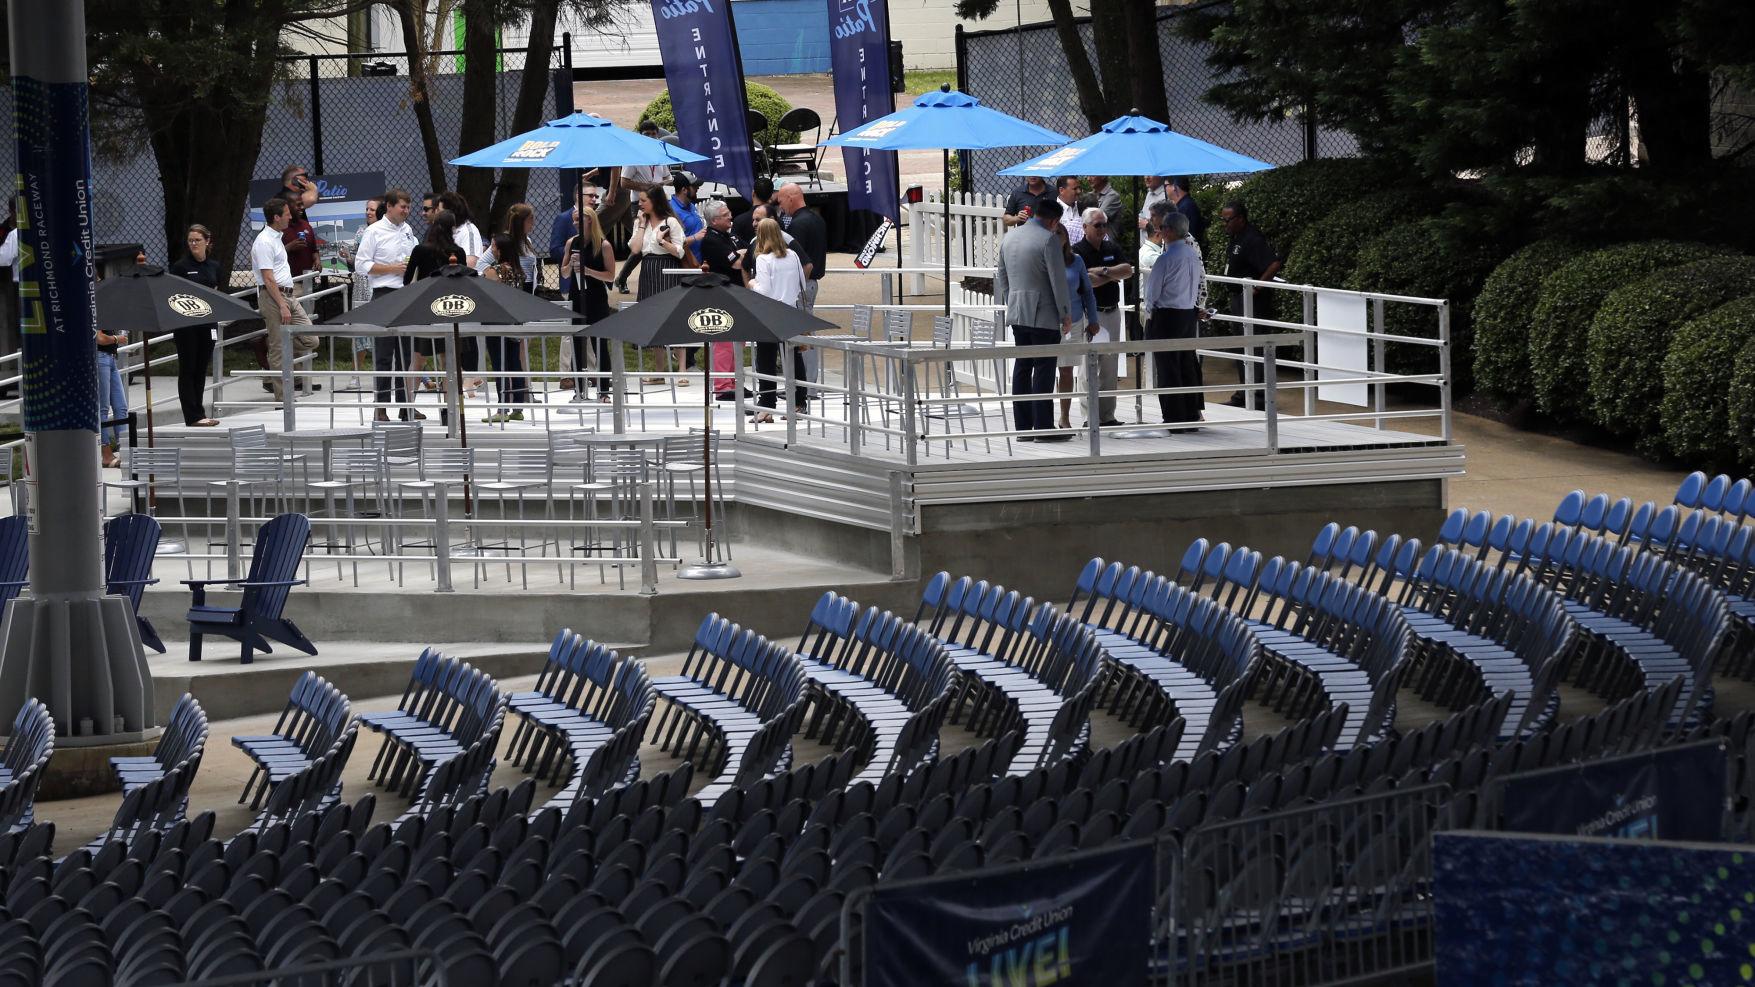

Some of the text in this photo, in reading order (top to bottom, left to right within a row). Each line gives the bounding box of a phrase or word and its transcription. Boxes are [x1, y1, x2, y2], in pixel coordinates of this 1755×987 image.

[75, 179, 88, 227] Union
[29, 174, 65, 333] AT RICHMOND RACEWAY
[81, 229, 95, 278] Credit
[442, 300, 465, 310] DB
[699, 314, 723, 326] DB
[1010, 915, 1043, 941] Credit
[1044, 906, 1073, 928] Union
